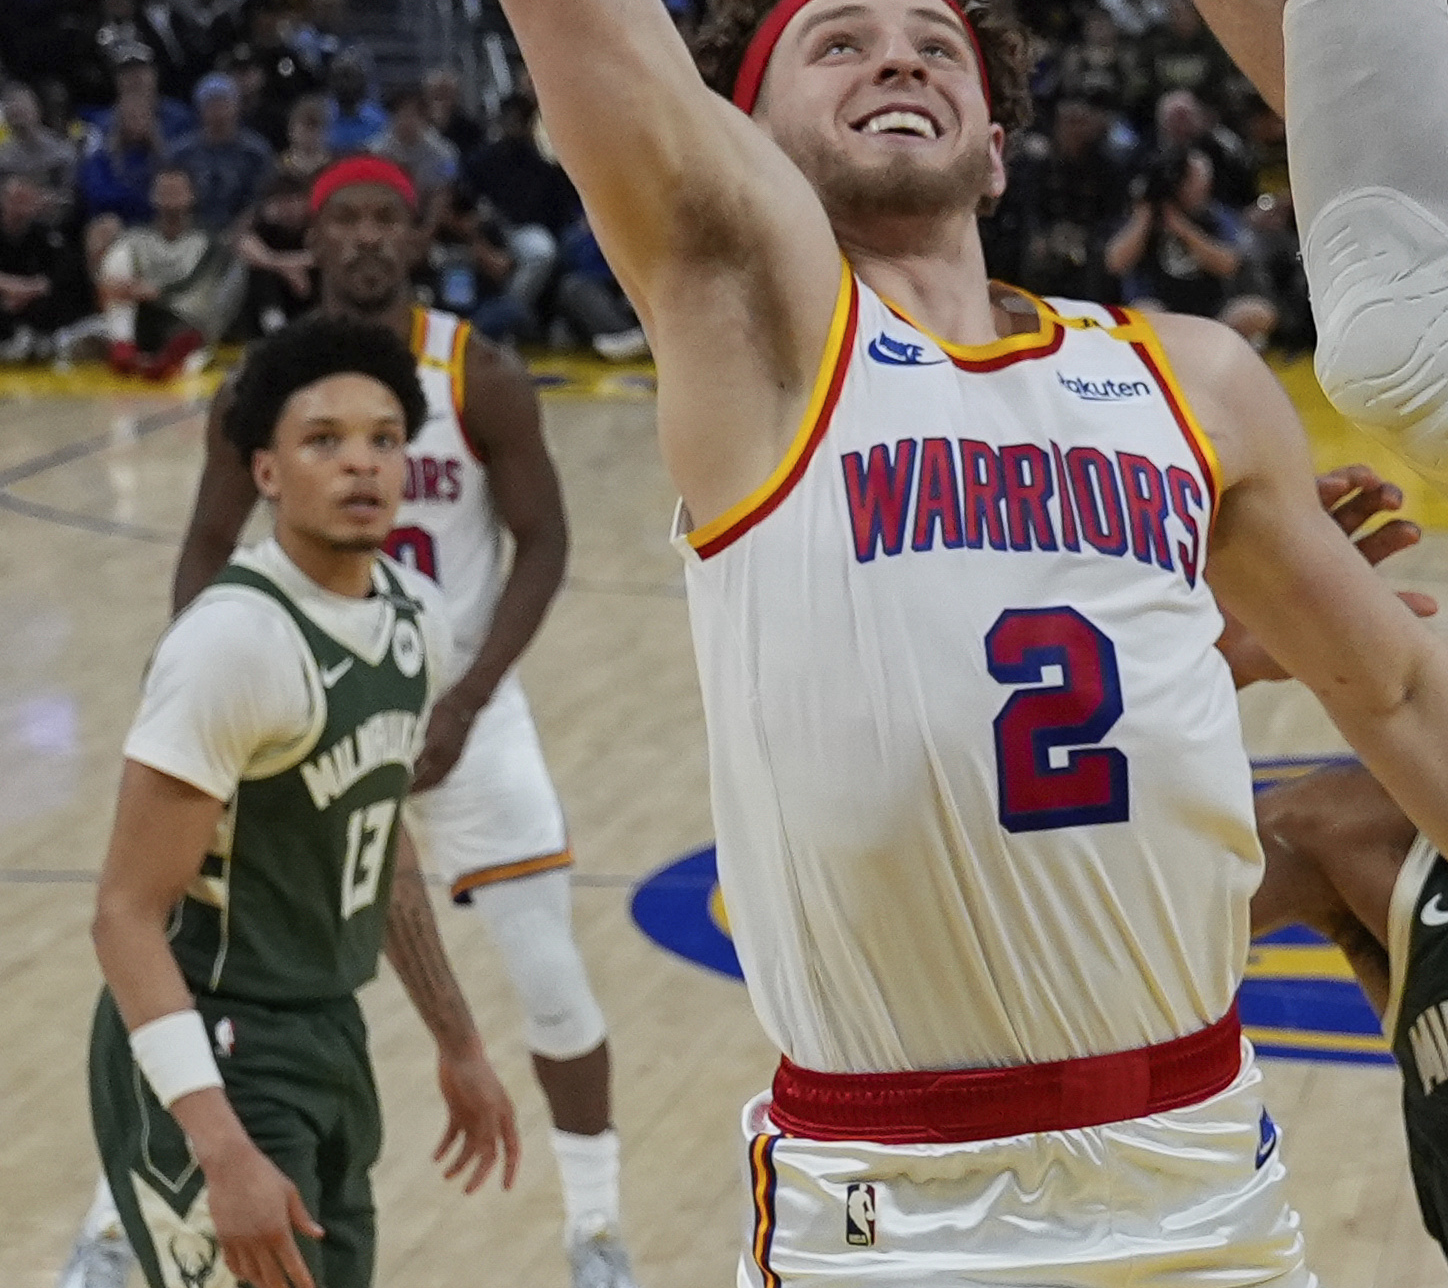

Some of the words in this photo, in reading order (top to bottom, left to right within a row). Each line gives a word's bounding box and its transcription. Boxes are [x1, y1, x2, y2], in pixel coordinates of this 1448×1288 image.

[841, 437, 1203, 589] WARRIORS
[984, 605, 1130, 834] 2
[340, 797, 398, 921] 13
